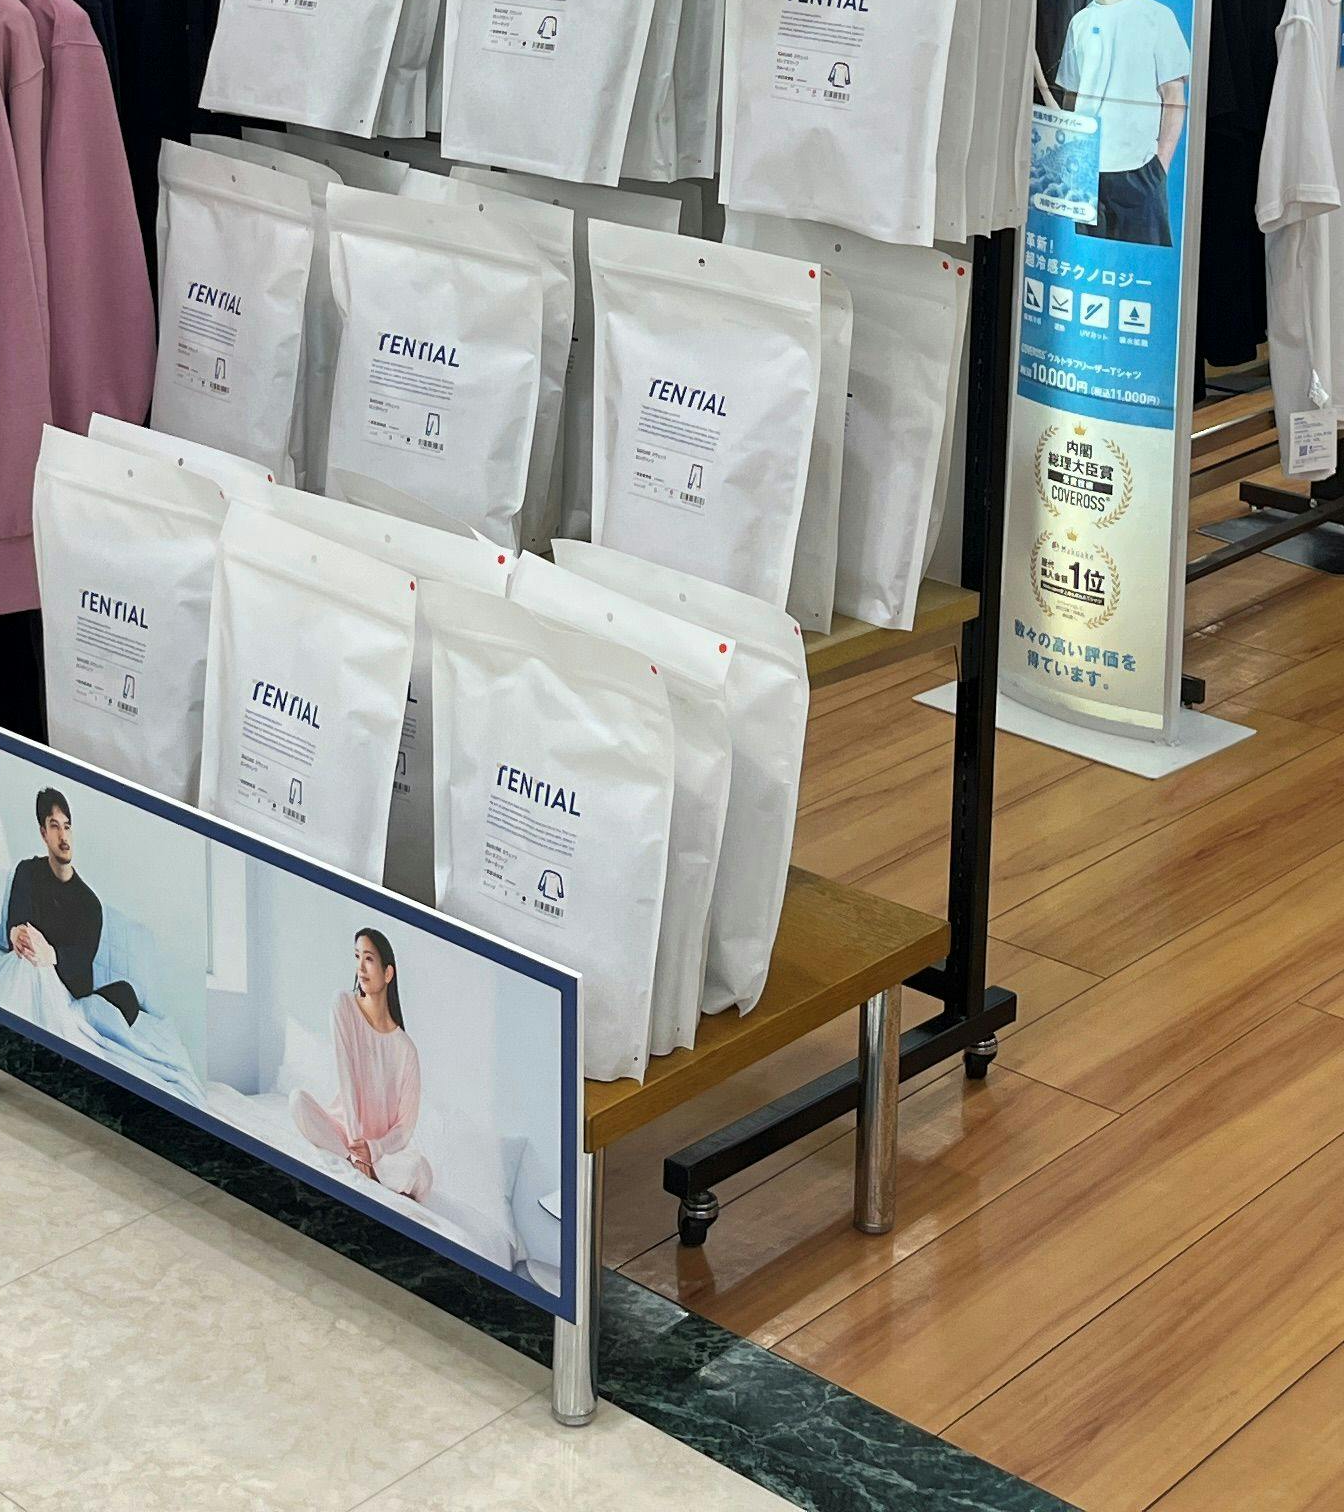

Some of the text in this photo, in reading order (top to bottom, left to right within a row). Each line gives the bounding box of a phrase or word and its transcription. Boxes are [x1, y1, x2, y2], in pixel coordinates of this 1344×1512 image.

[1025, 250, 1152, 288] 超冷感テクノロジー
[186, 281, 243, 317] TENTIAL
[376, 331, 461, 369] TENTIAL
[648, 377, 728, 418] TENTIAL
[1047, 451, 1114, 482] 総理大臣賞
[1066, 440, 1093, 460] 内閣
[1068, 561, 1106, 595] 1位
[79, 588, 150, 631] TENTIAL
[1014, 618, 1137, 673] 数々の高い評価を
[1027, 649, 1110, 691] 得ています。
[250, 679, 321, 731] TENTIAL
[494, 762, 583, 819] TENTIAL
